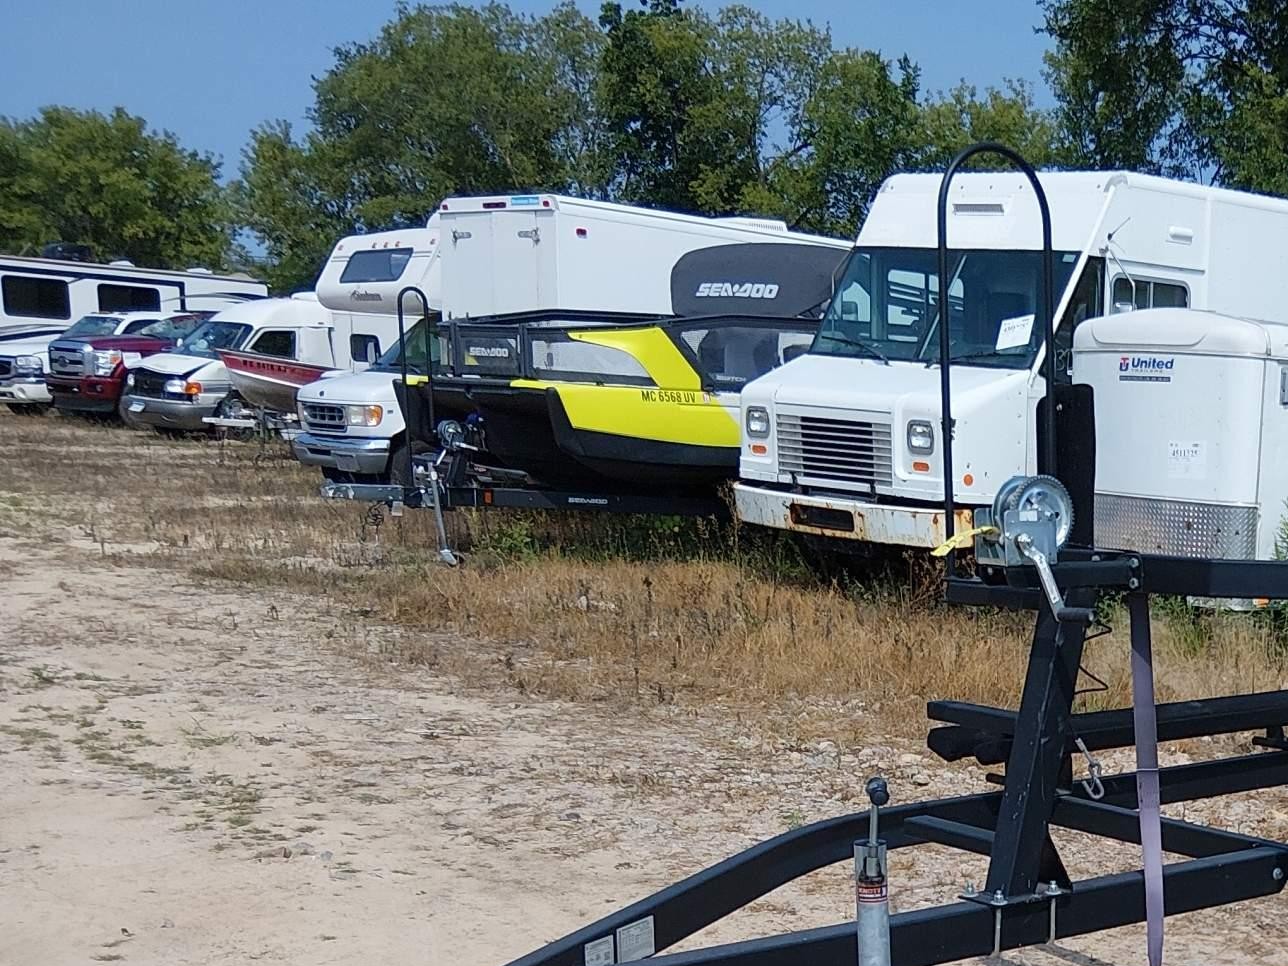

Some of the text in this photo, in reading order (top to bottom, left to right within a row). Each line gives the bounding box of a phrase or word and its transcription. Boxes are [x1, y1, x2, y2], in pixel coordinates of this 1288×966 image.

[1131, 357, 1174, 369] United
[641, 391, 657, 402] MC
[658, 391, 682, 402] 6568
[683, 392, 696, 403] UV
